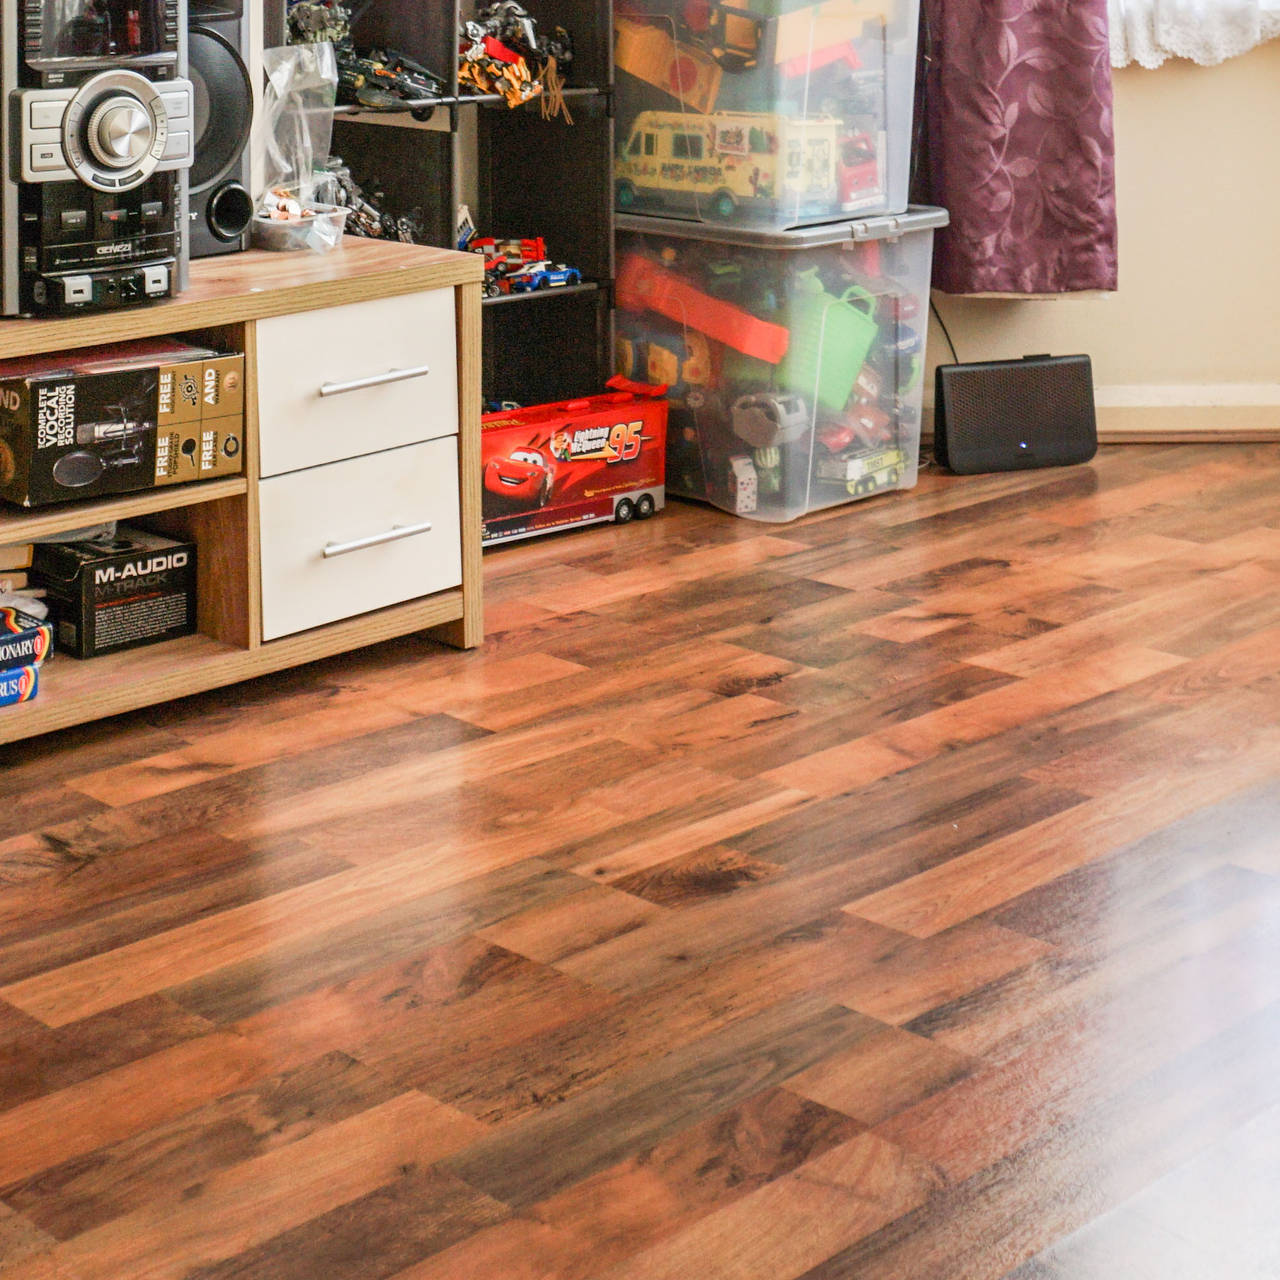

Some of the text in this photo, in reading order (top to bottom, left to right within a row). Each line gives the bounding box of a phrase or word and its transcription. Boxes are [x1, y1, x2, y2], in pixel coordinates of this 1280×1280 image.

[159, 372, 172, 413] FREE
[204, 368, 216, 405] AND
[37, 387, 48, 445] COMPLETE
[46, 386, 60, 447] VOCAL
[57, 386, 67, 447] RECORDING
[65, 384, 76, 445] SOLUTION
[574, 426, 610, 442] Lightning
[157, 436, 169, 477] FREE
[202, 431, 214, 470] FREE
[607, 420, 644, 464] 95
[95, 552, 188, 585] M-AUDIO
